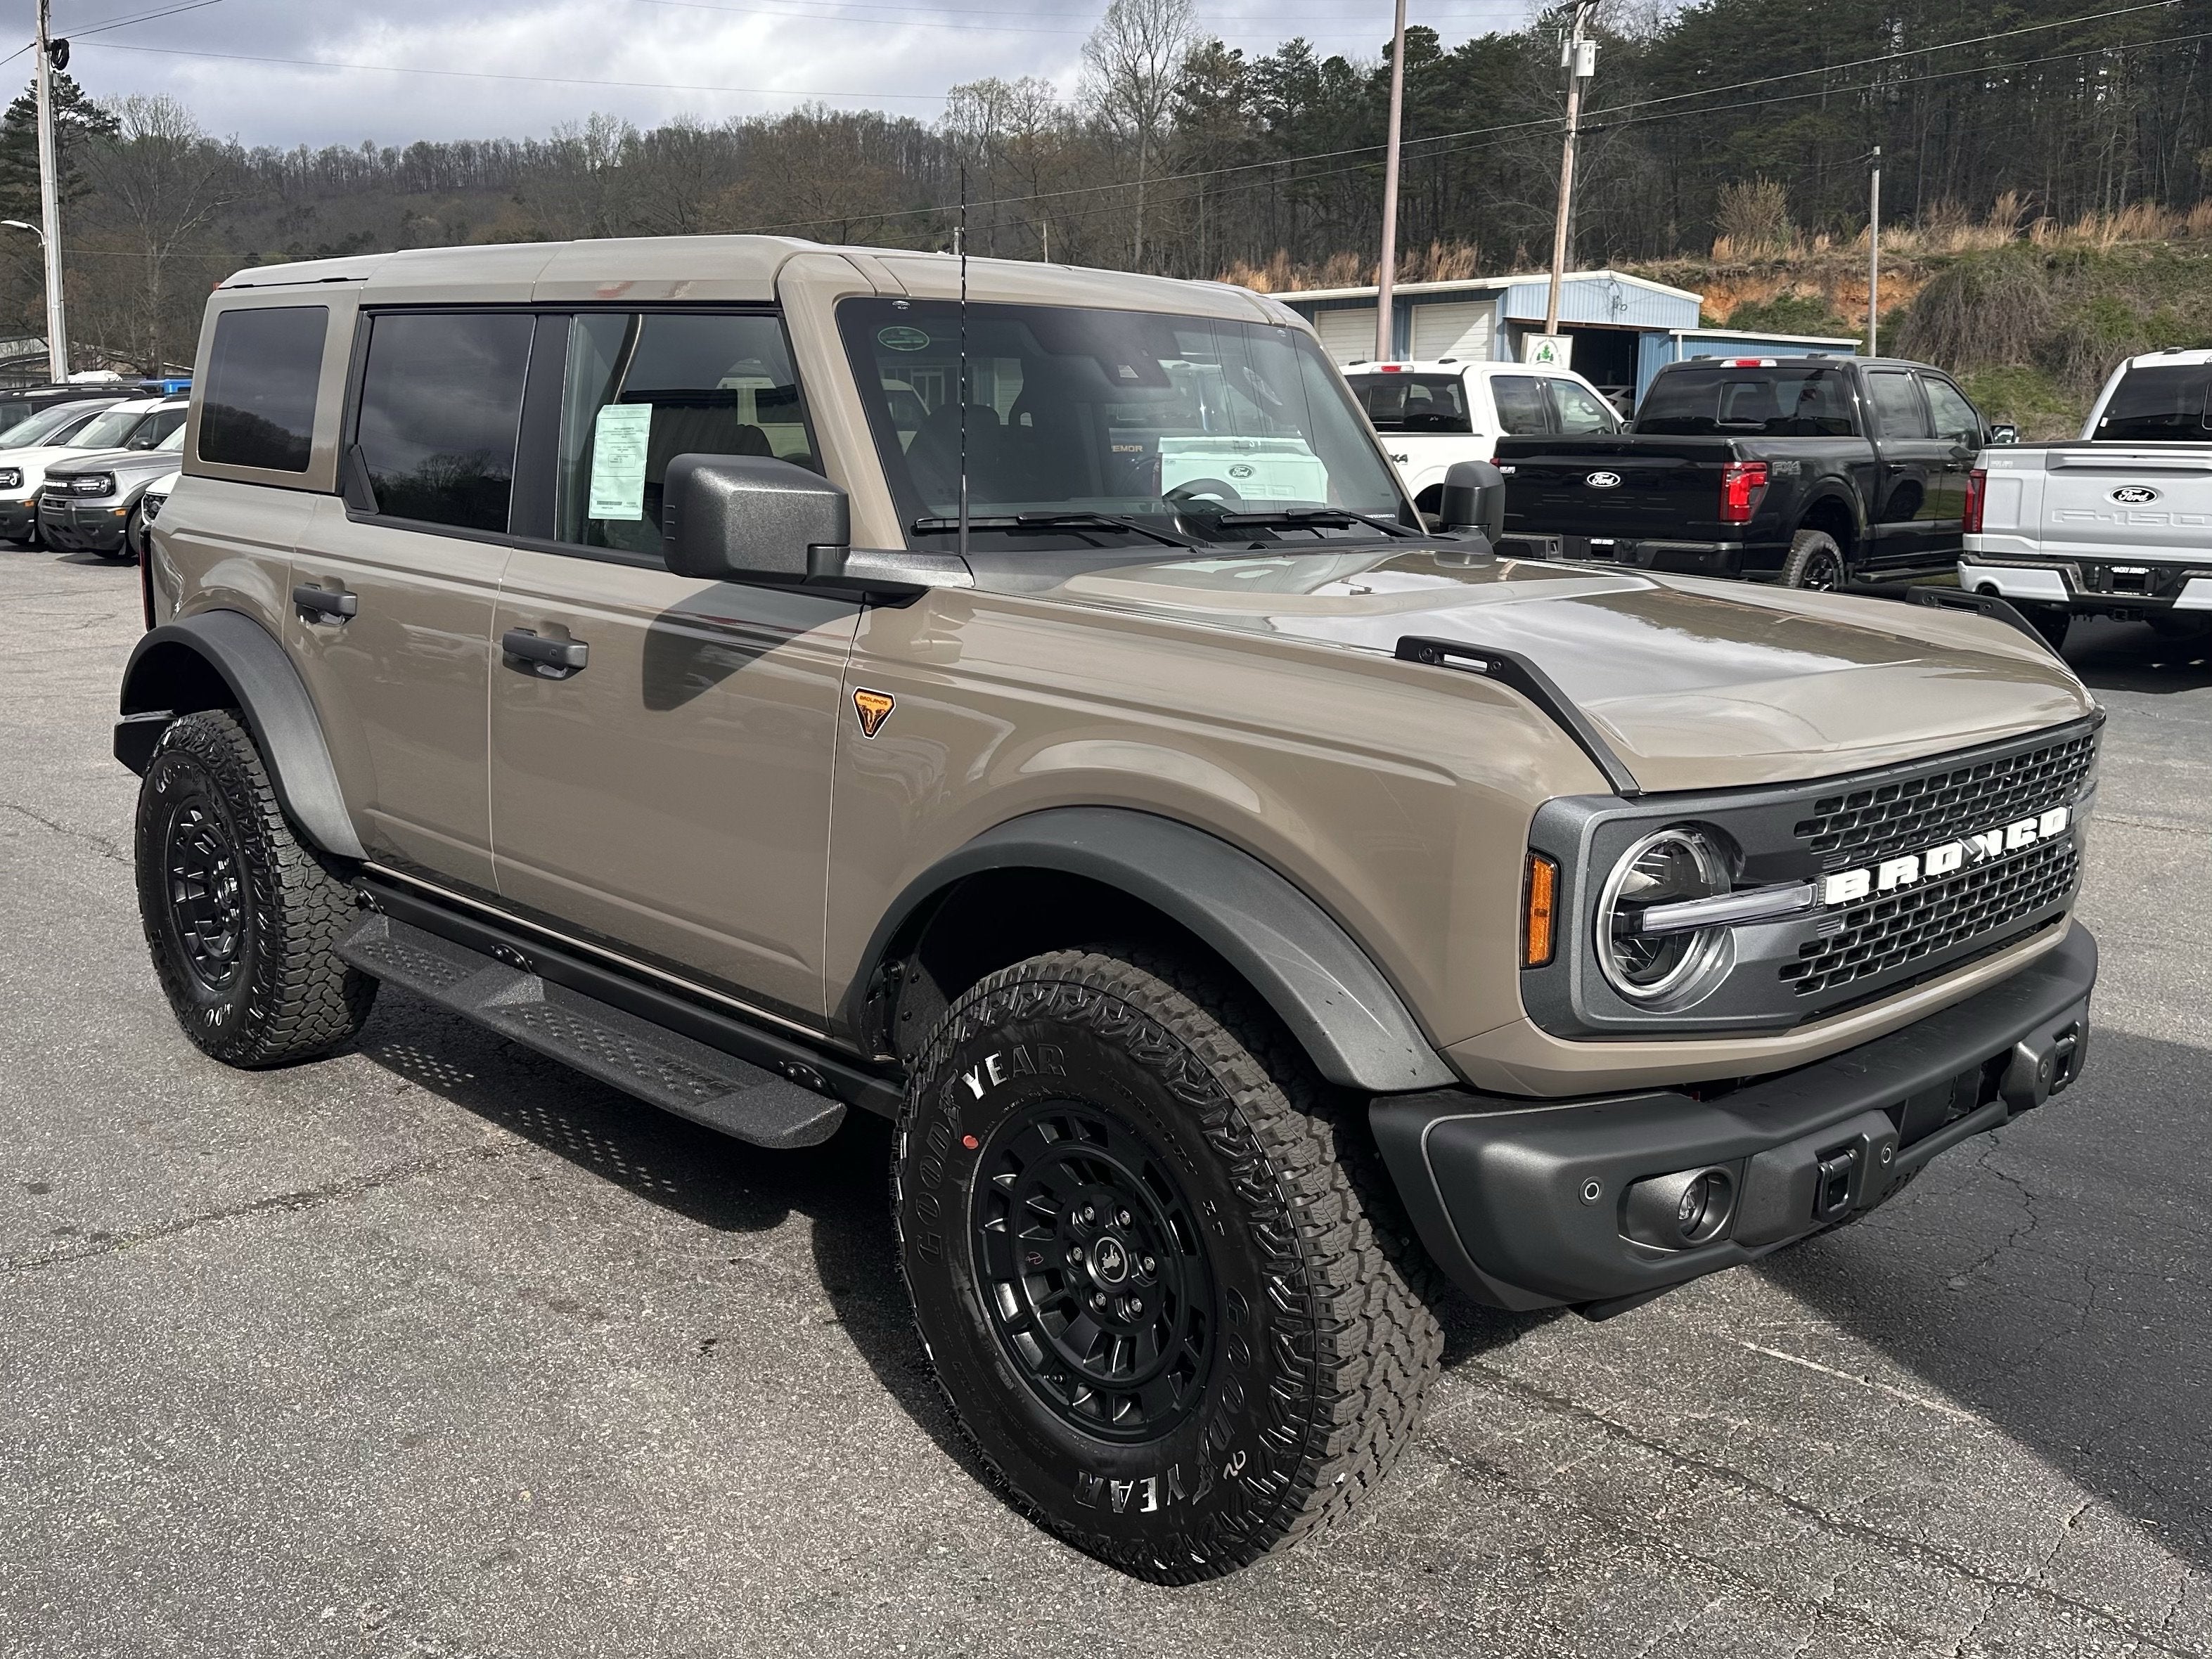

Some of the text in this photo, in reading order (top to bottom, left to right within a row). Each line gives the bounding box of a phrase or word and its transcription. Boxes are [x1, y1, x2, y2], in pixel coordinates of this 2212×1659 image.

[1772, 461, 1801, 476] FX4
[1592, 474, 1615, 485] Ford
[2118, 489, 2149, 503] Ford
[2052, 508, 2212, 527] F-150
[859, 695, 888, 706] BADLANDS
[1825, 806, 2067, 905] BRONCO
